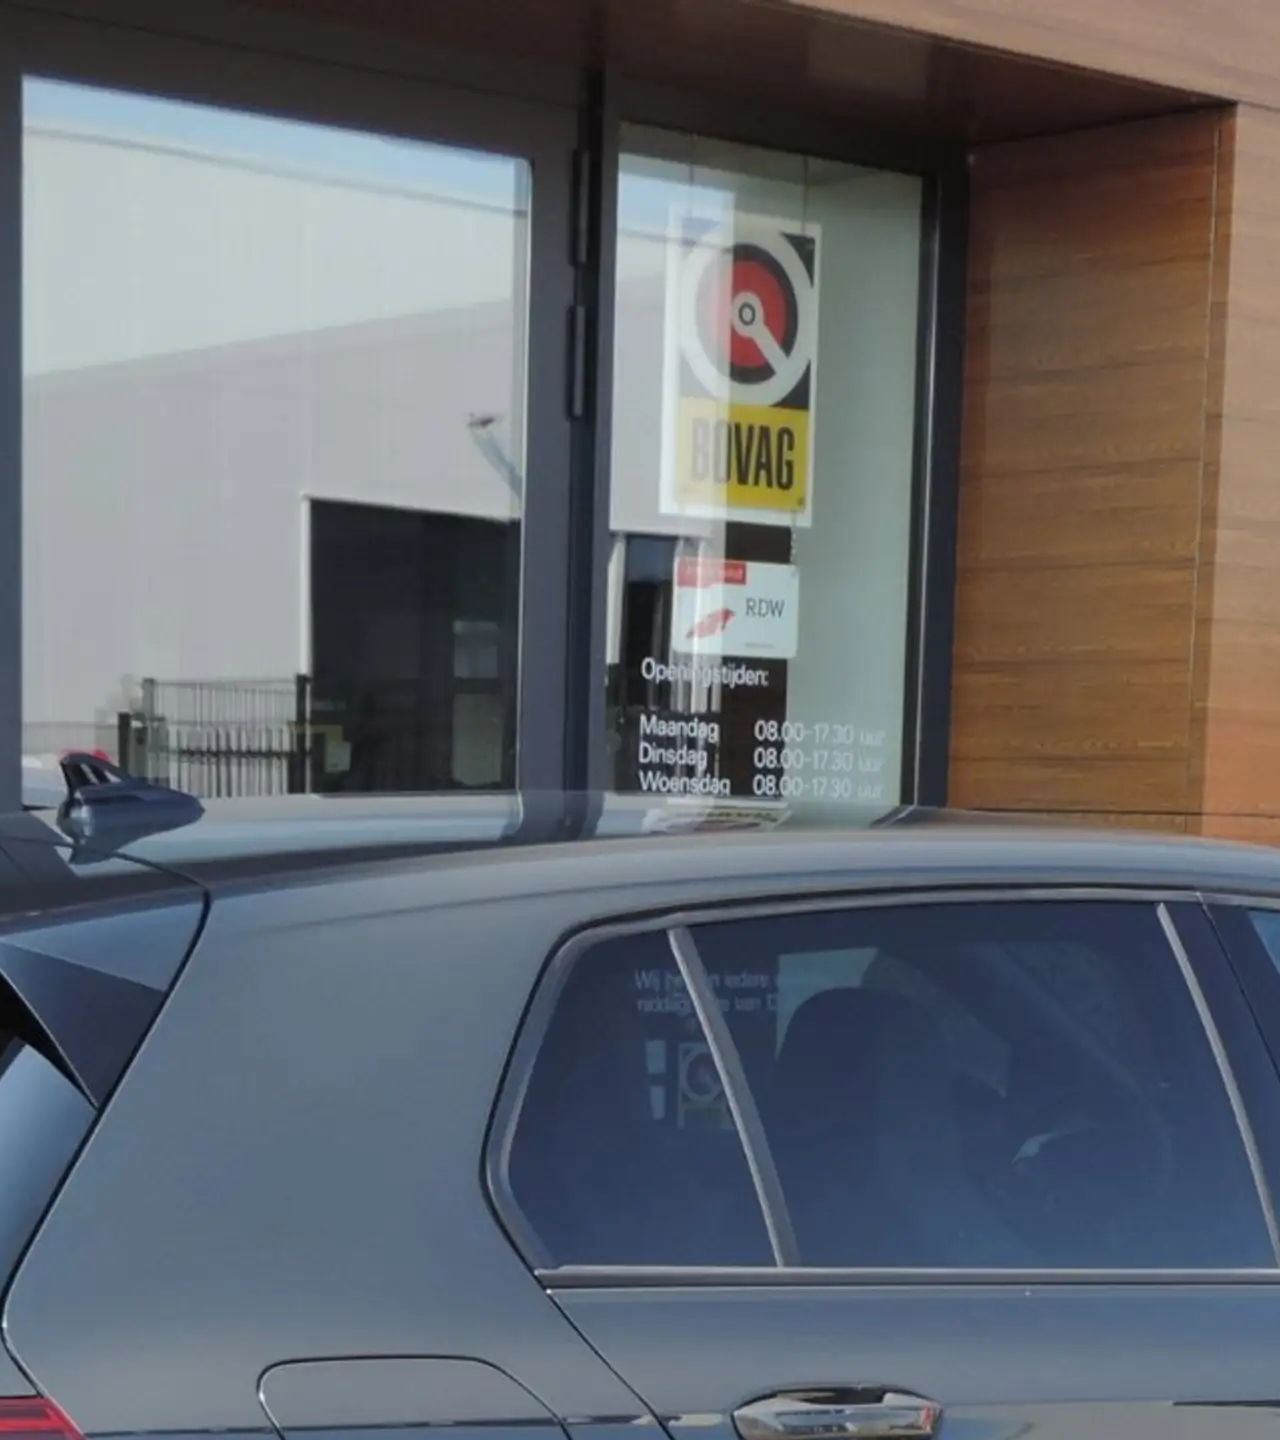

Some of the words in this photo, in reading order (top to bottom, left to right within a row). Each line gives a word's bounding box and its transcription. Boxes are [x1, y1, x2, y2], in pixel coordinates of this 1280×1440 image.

[691, 418, 794, 491] BOVAG
[746, 598, 785, 618] RDW
[641, 658, 769, 688] Openingstijden:
[640, 714, 719, 743] Maandag
[639, 742, 708, 769] Dinsdag
[638, 771, 730, 796] Woensdag
